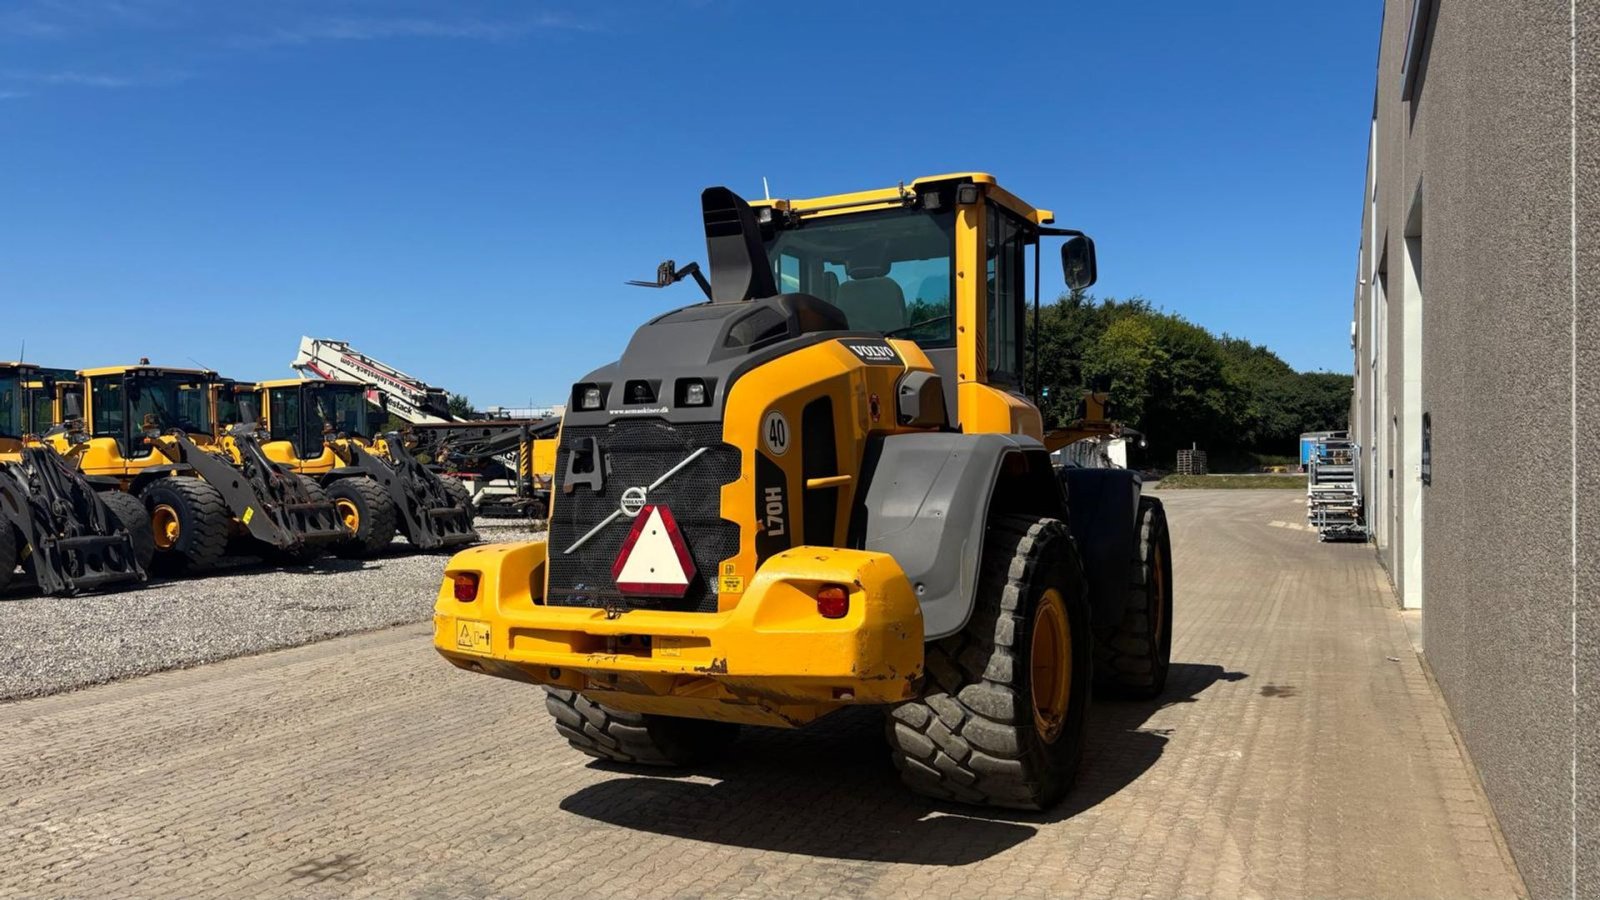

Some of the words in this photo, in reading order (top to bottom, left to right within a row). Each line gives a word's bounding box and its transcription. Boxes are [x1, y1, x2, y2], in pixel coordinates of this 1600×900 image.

[850, 345, 895, 357] VOLVO
[769, 418, 786, 447] 40
[764, 487, 785, 537] L70H
